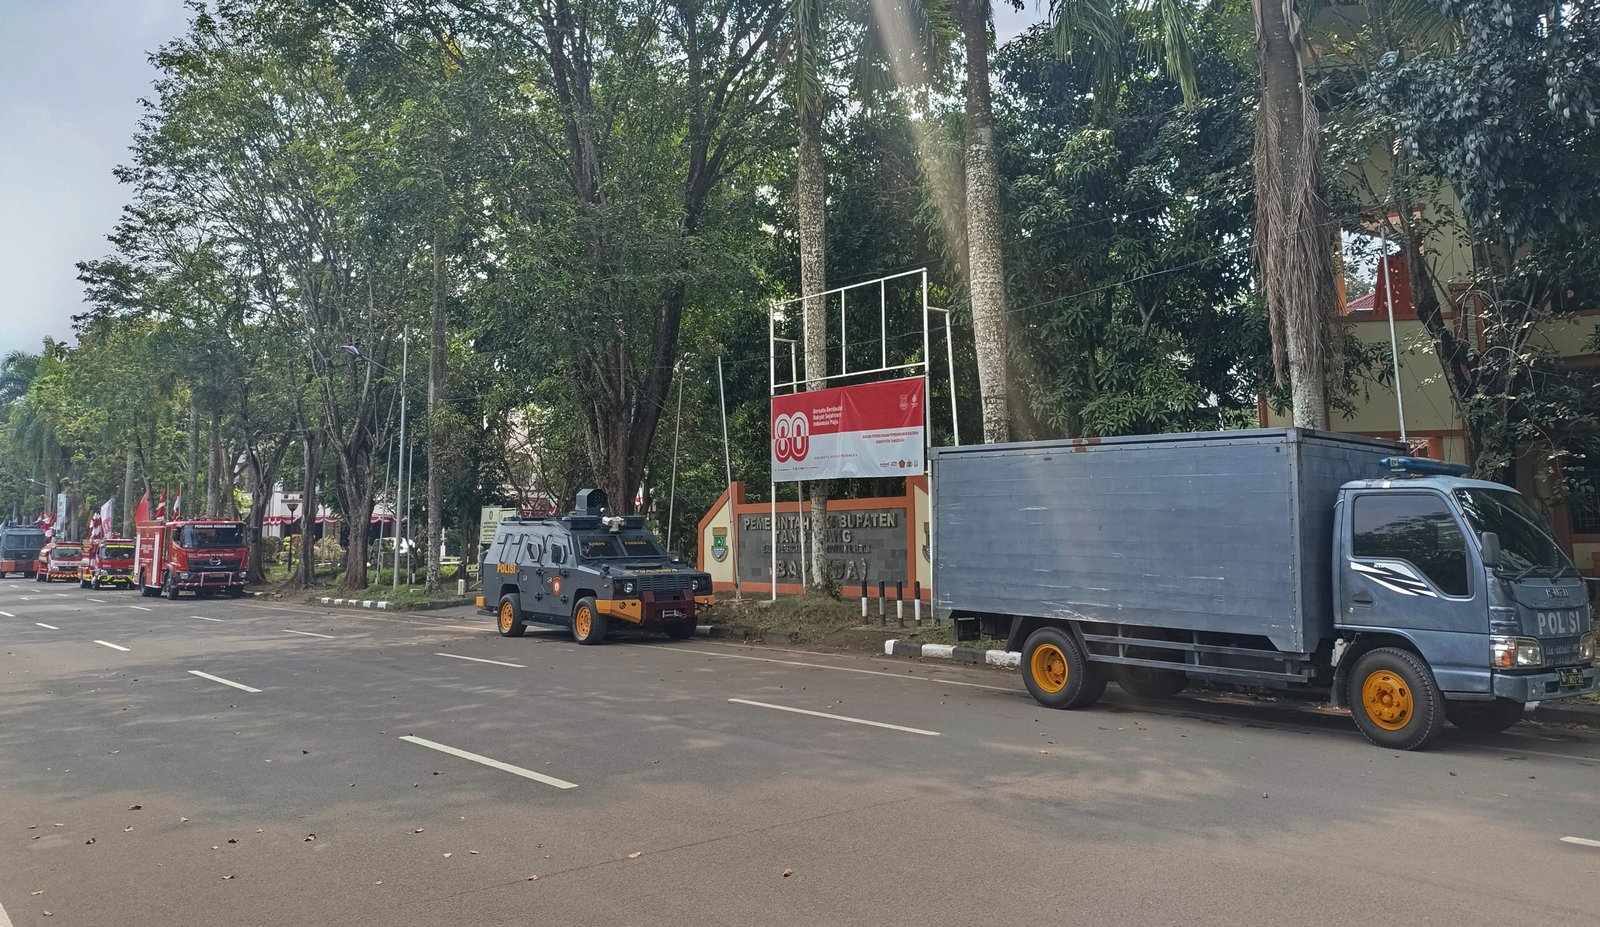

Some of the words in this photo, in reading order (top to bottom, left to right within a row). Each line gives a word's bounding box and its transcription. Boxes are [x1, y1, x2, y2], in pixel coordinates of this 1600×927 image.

[774, 411, 809, 463] 80
[744, 516, 811, 530] PEMEINTAH
[497, 564, 516, 574] POLISI
[1537, 611, 1580, 635] POLSI
